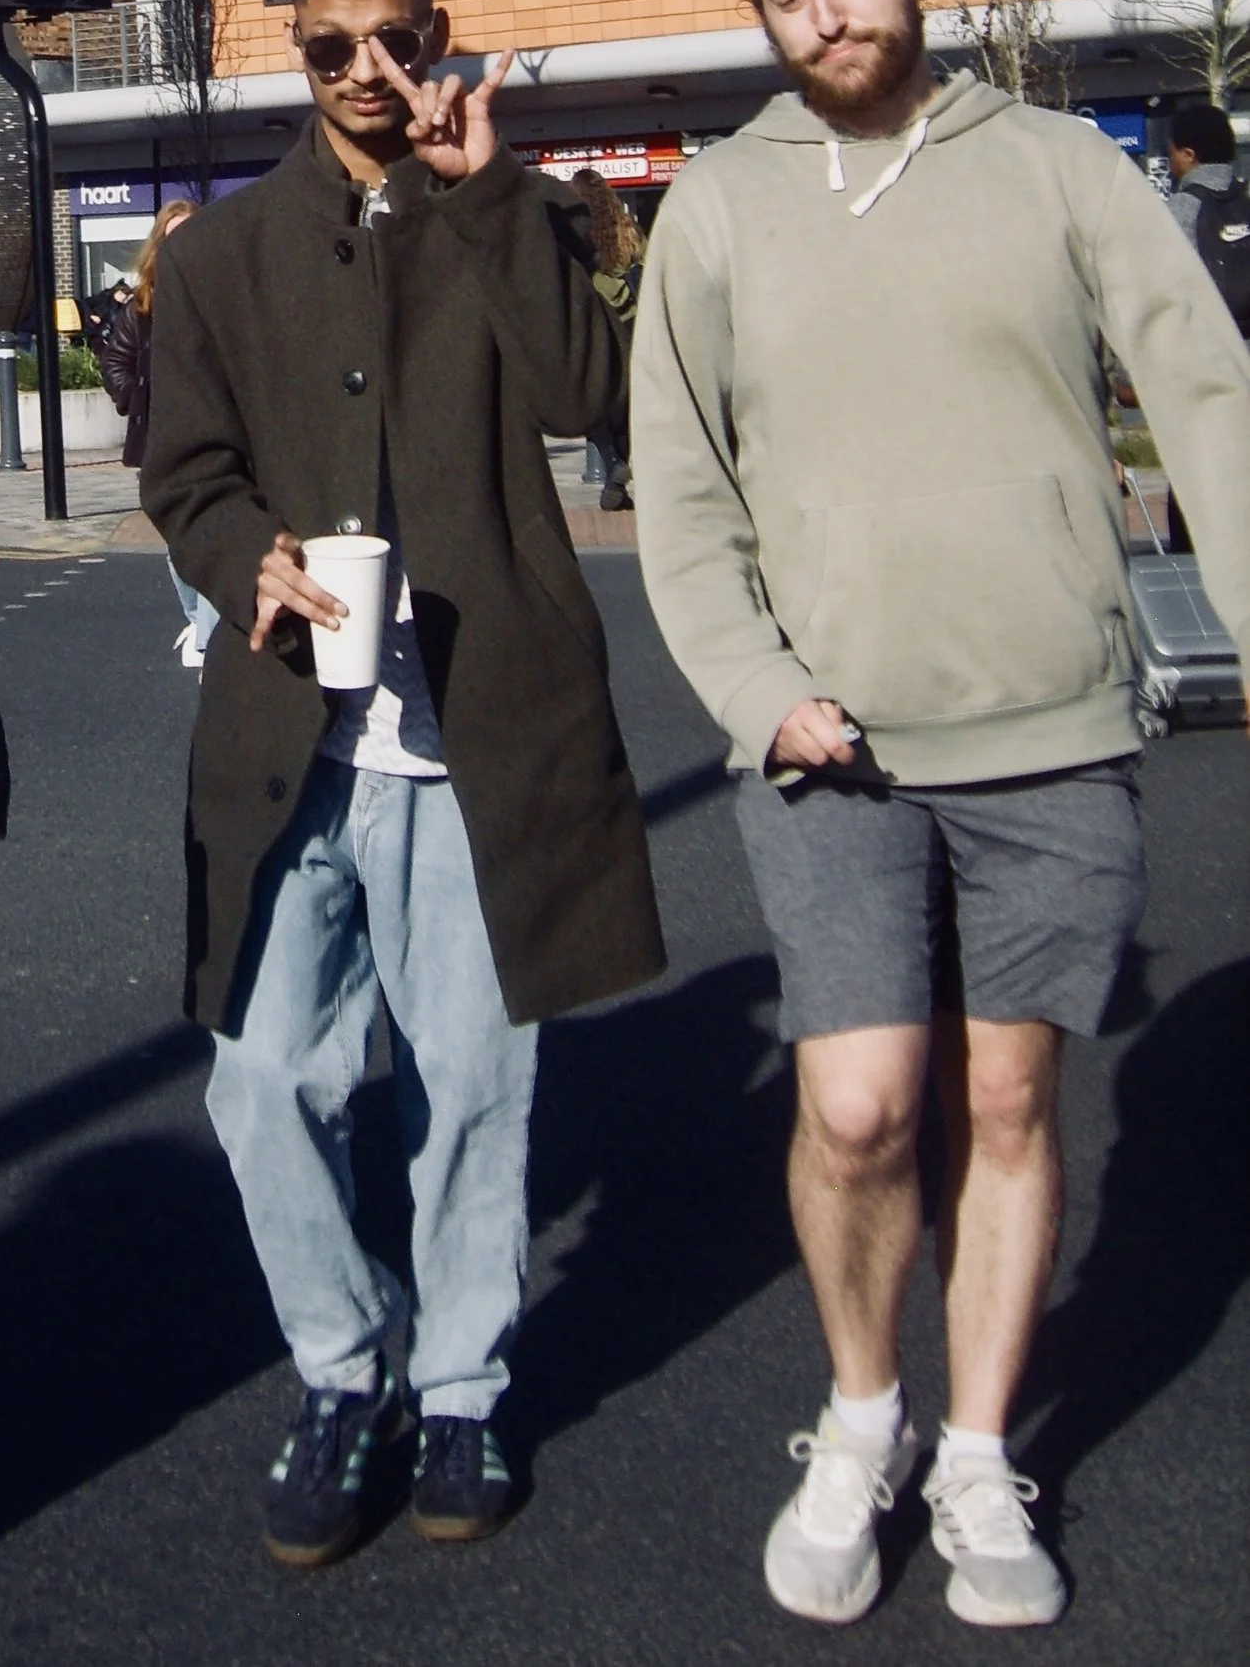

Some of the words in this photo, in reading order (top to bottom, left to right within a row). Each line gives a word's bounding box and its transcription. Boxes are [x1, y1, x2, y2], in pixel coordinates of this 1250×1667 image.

[553, 144, 603, 160] DESIGN
[614, 142, 647, 156] WEB
[80, 183, 131, 205] haart
